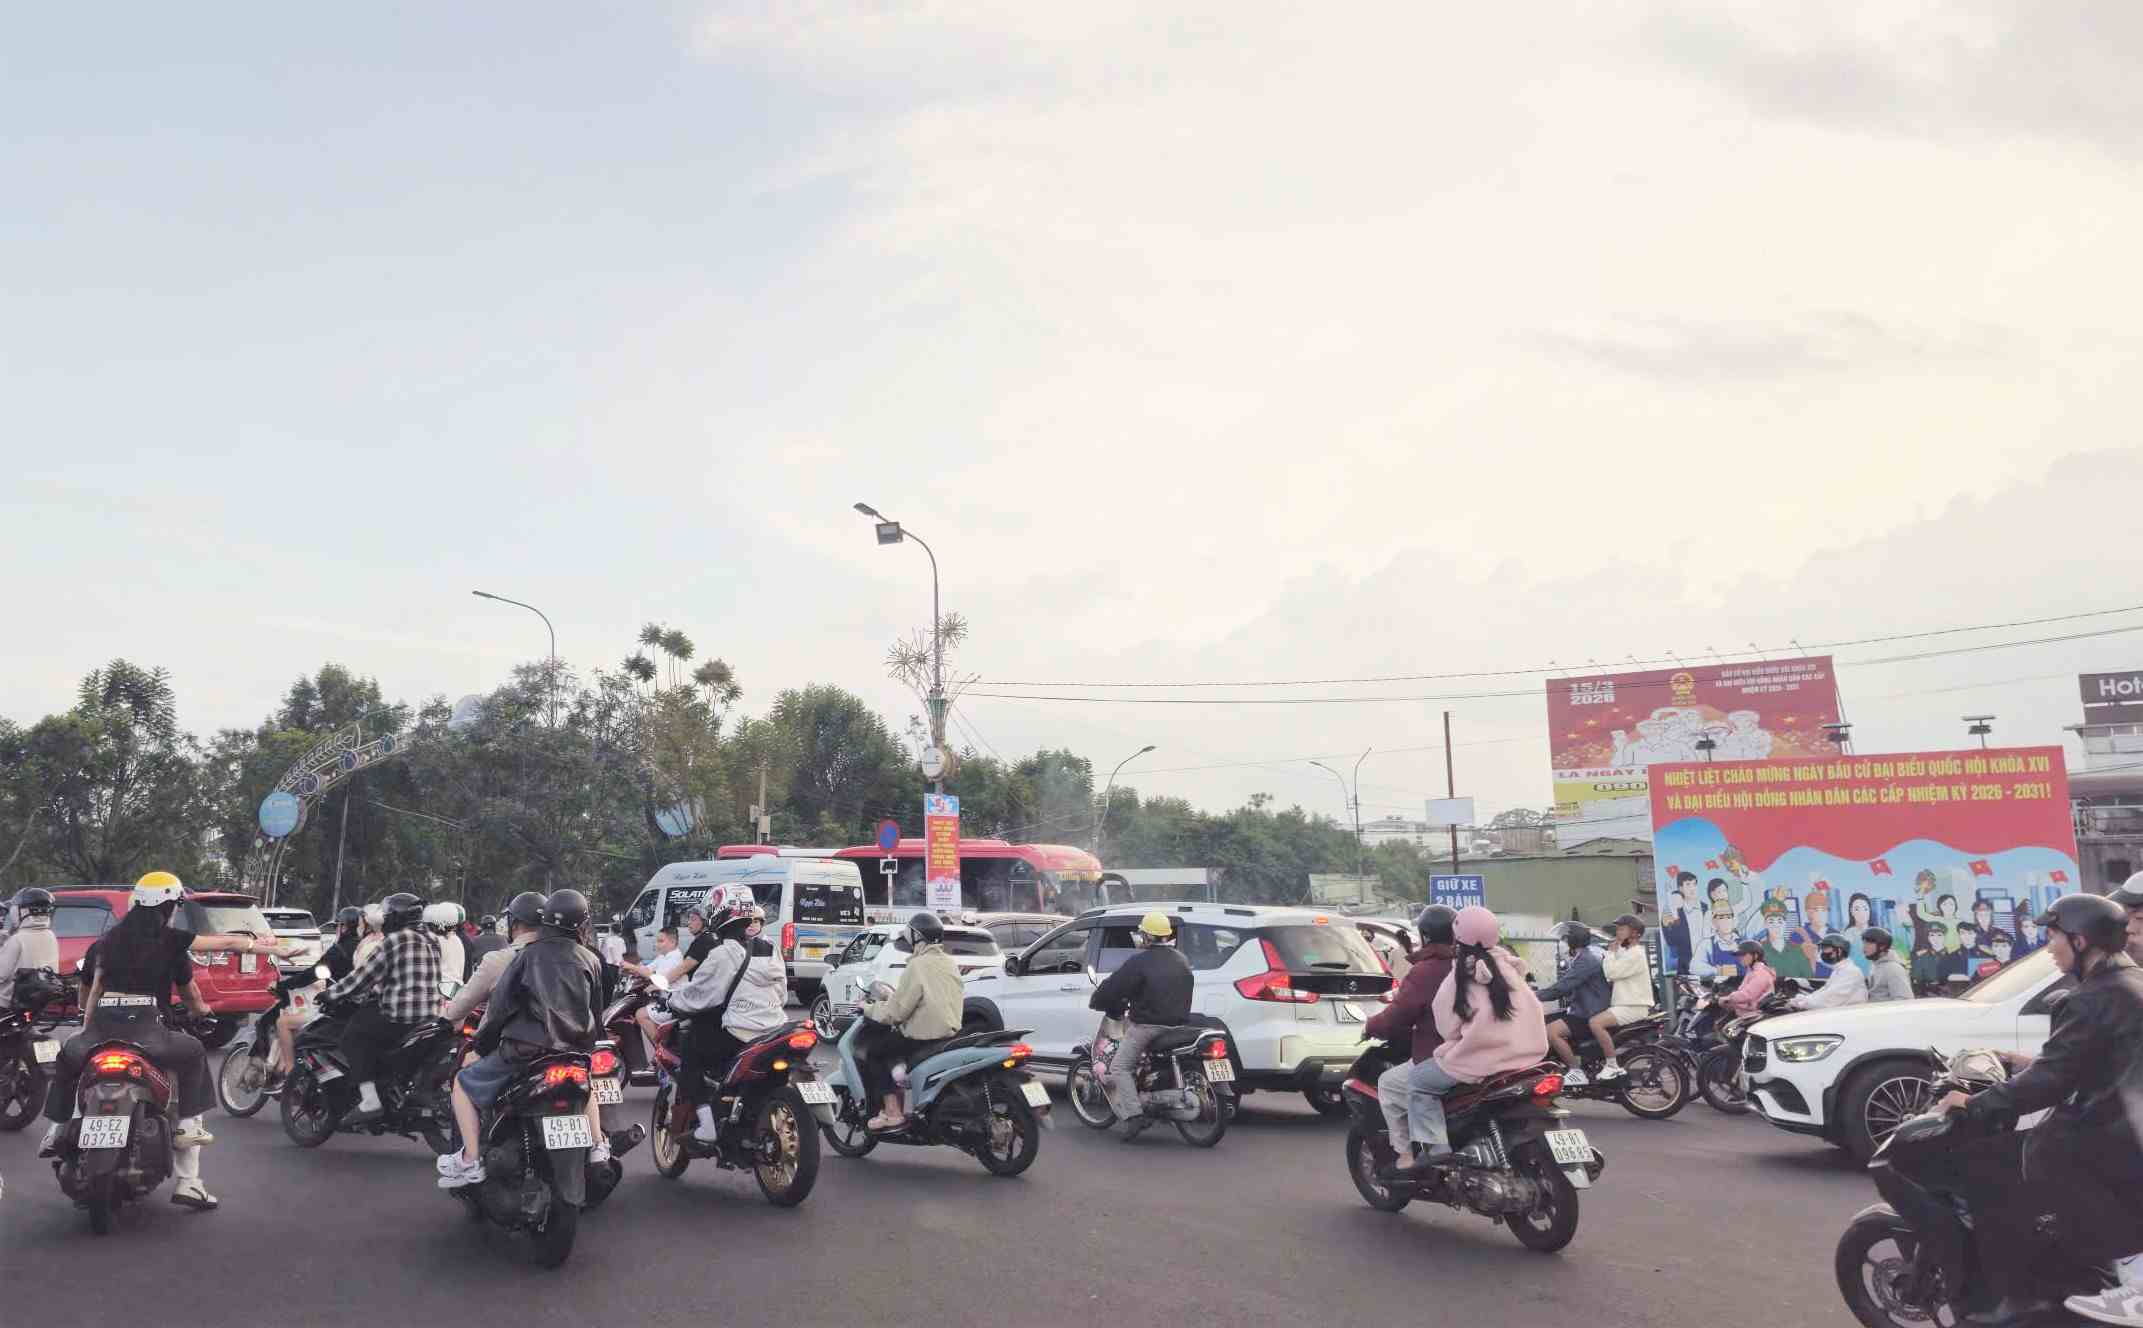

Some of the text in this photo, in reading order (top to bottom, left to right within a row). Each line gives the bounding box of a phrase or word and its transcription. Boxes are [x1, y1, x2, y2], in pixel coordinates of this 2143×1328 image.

[2098, 677, 2143, 696] Hot
[1664, 768, 1695, 787] NHIỆT
[1698, 767, 1721, 786] LIỆT
[1723, 766, 1753, 784] CHÀO
[1756, 765, 1790, 783] MỪNG
[1794, 763, 1824, 781] NGÀY
[1827, 760, 1851, 780] BẦU
[1855, 758, 1872, 778] CỬ
[1872, 762, 1894, 780] ĐẠI
[1898, 757, 1925, 777] BIỂU
[1928, 756, 1962, 777] QUỐC
[1966, 756, 1987, 778] HỘI
[2028, 756, 2050, 773] XVI
[1667, 791, 1682, 810] VÀ
[1684, 794, 1703, 812] ĐẠI
[1705, 789, 1730, 808] BIỂU
[1733, 790, 1752, 810] HỘI
[1755, 788, 1787, 807] ĐỒNG
[1789, 788, 1823, 806] NHÂN
[1825, 786, 1851, 805] DÂN
[1853, 784, 1877, 804] CÁC
[1880, 782, 1904, 803] CẤP
[1907, 783, 1949, 804] NHIỆM
[1972, 784, 2001, 800] 2026
[2014, 783, 2051, 800] 2031!
[1437, 878, 1478, 890] GIỮ XE
[1436, 896, 1443, 905] 2
